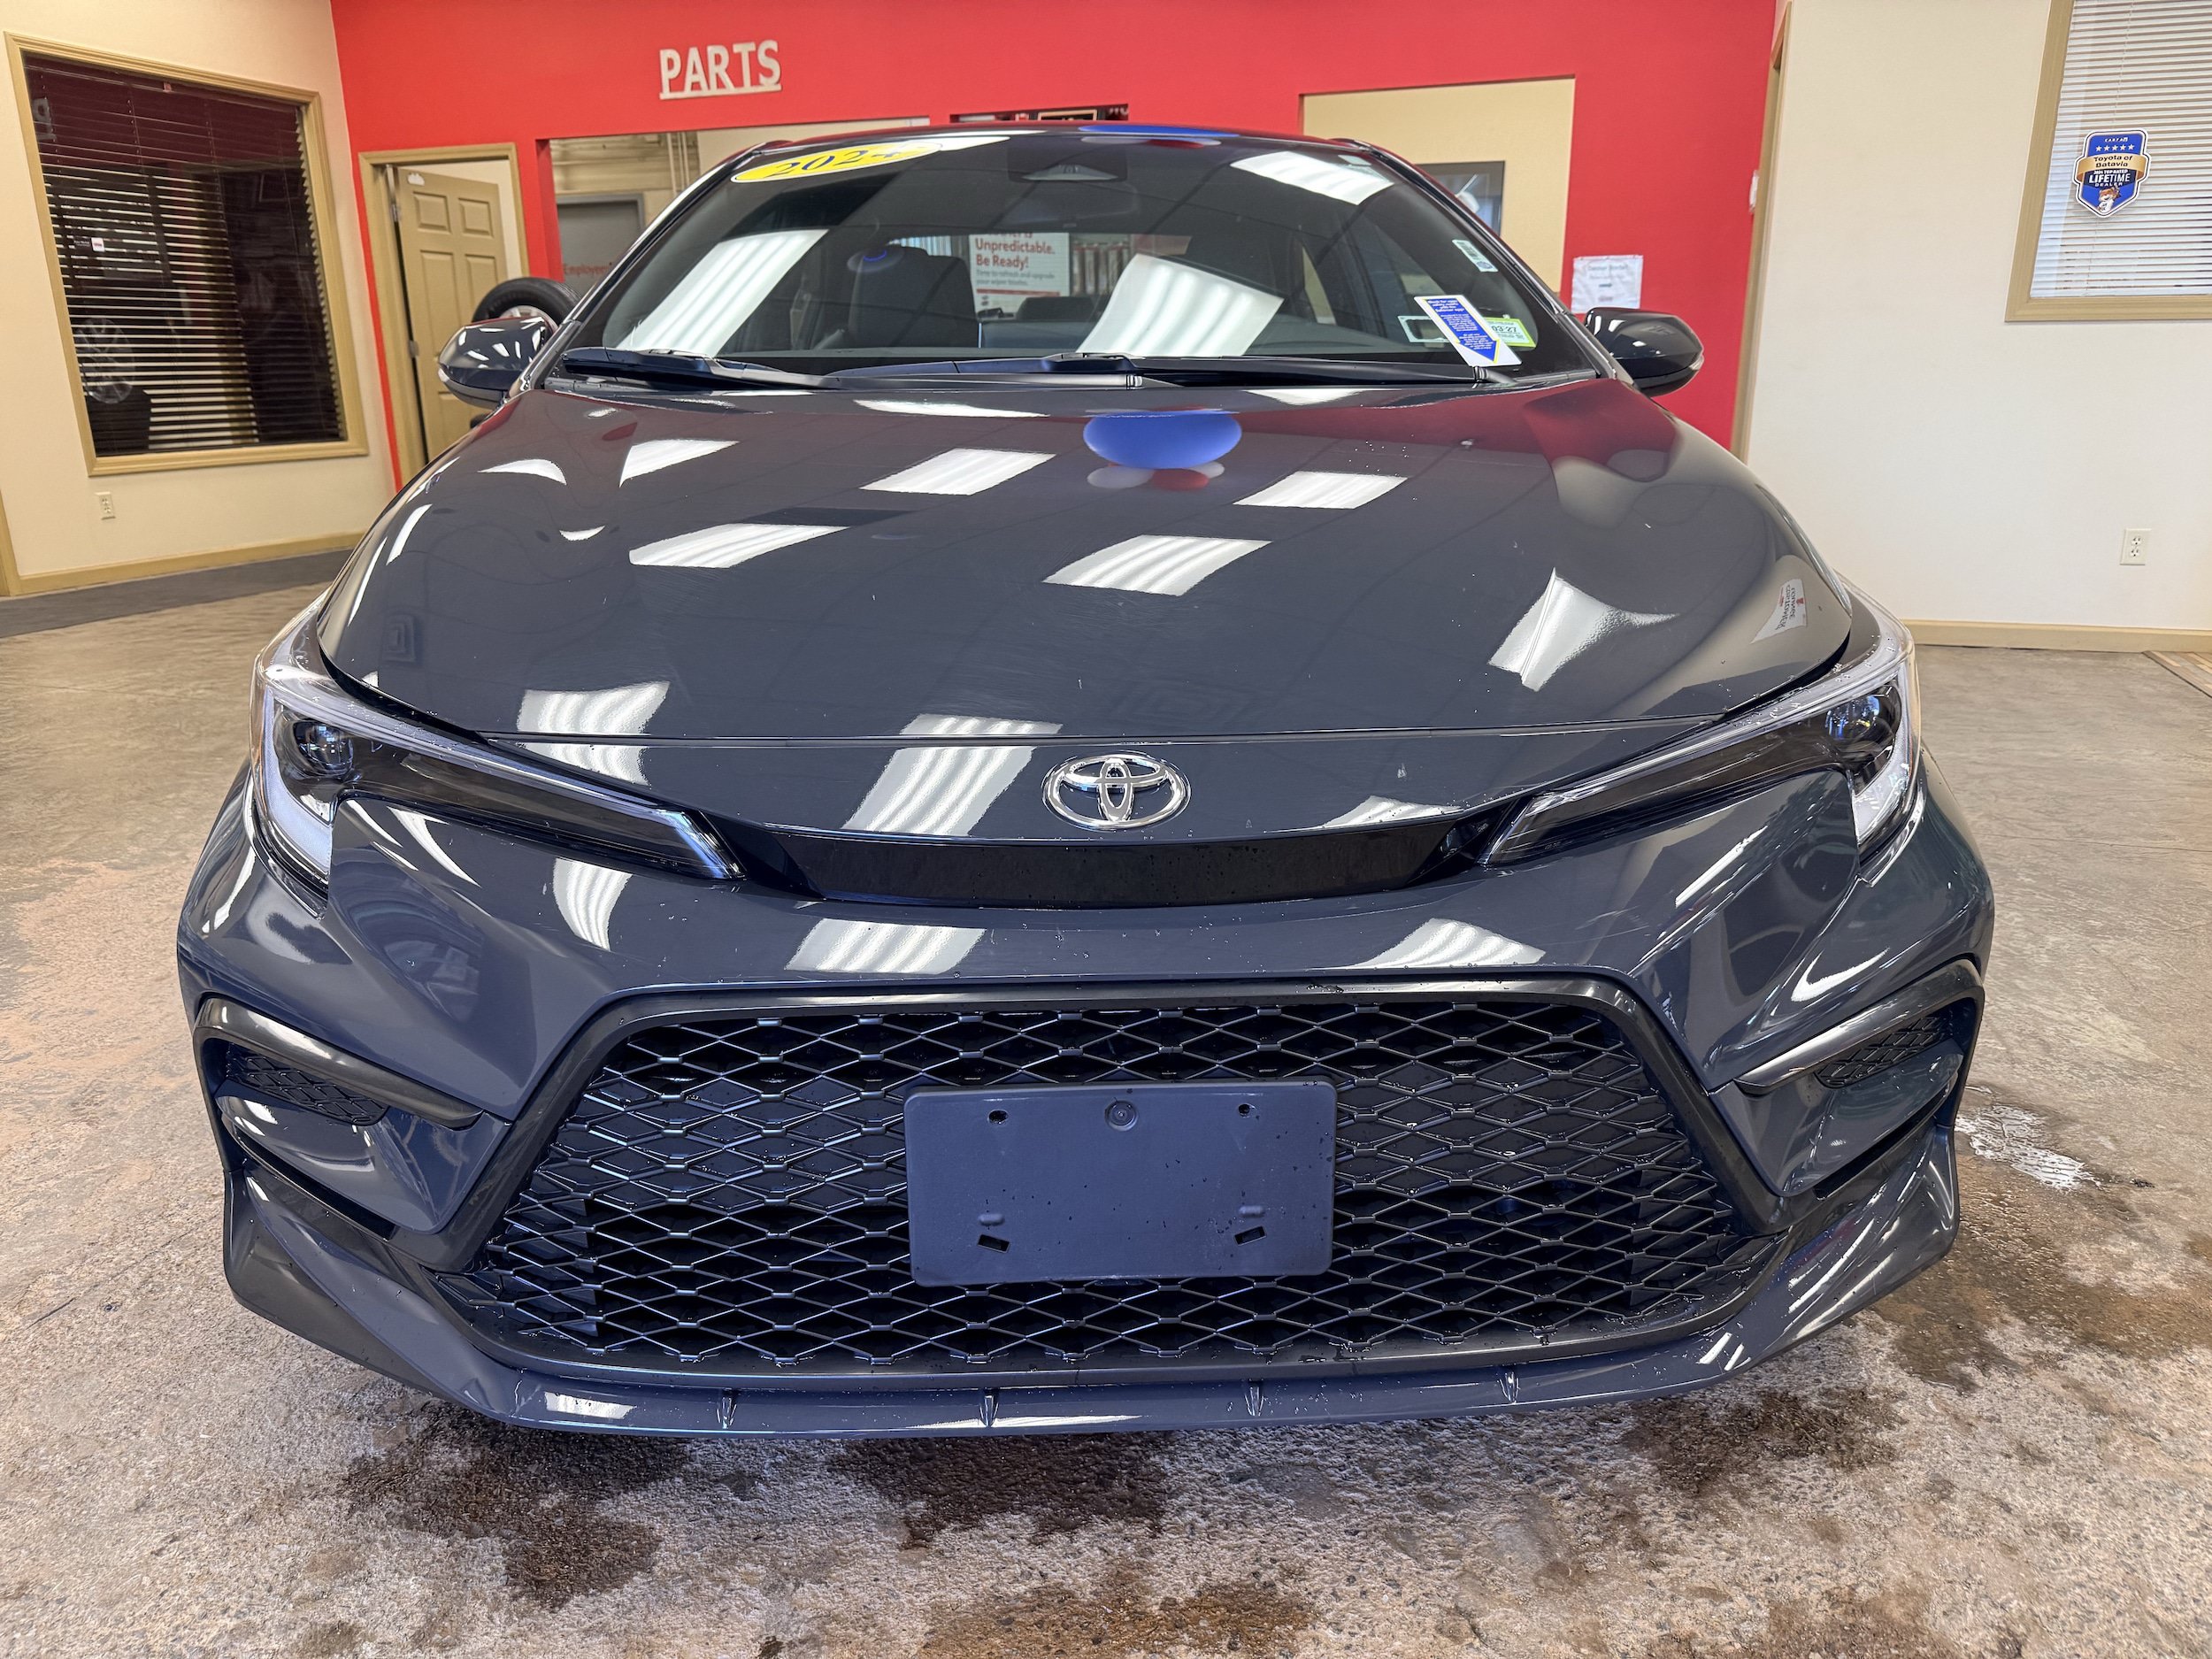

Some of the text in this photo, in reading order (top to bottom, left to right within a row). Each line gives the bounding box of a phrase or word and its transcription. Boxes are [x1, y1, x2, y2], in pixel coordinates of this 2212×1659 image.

[659, 41, 781, 96] PARTS
[2088, 173, 2131, 183] LIFETIME
[974, 238, 1056, 255] Unpredictable.
[976, 254, 1029, 271] Be Ready!
